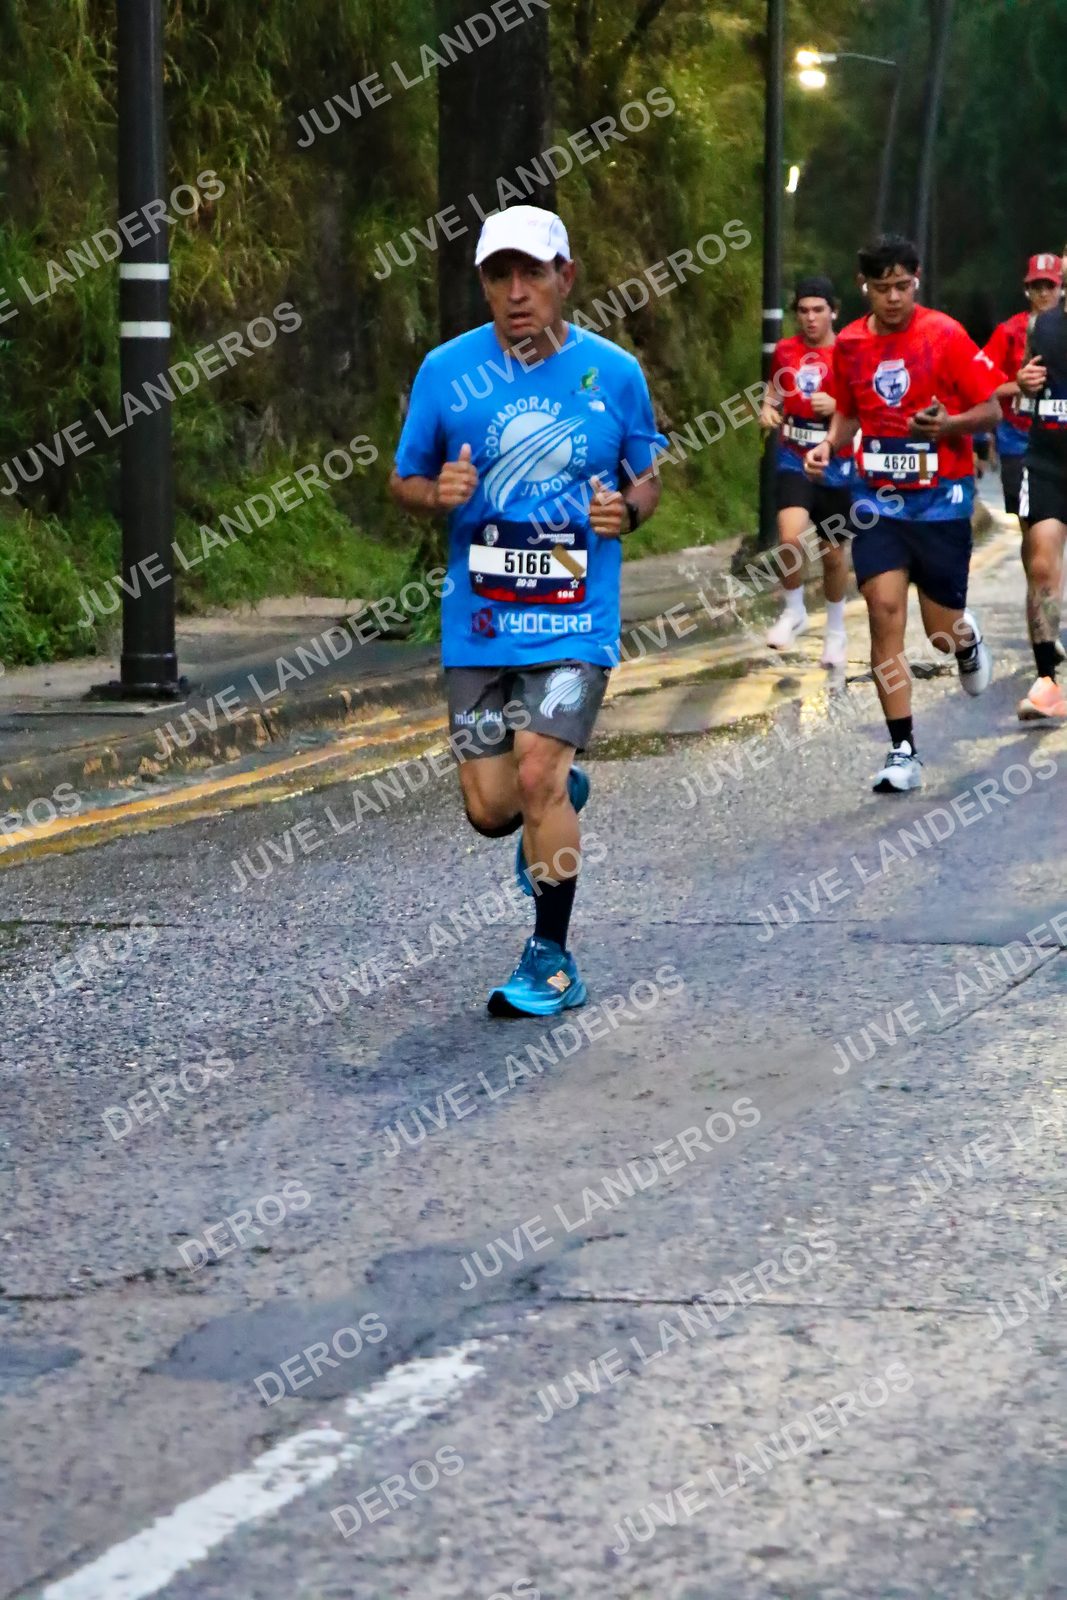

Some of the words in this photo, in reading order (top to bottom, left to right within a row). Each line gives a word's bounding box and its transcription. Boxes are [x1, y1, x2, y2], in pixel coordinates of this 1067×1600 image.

[485, 396, 562, 458] COPIADORAS
[884, 456, 916, 470] 4620
[504, 551, 550, 574] 5166
[498, 613, 592, 634] KYOCERA
